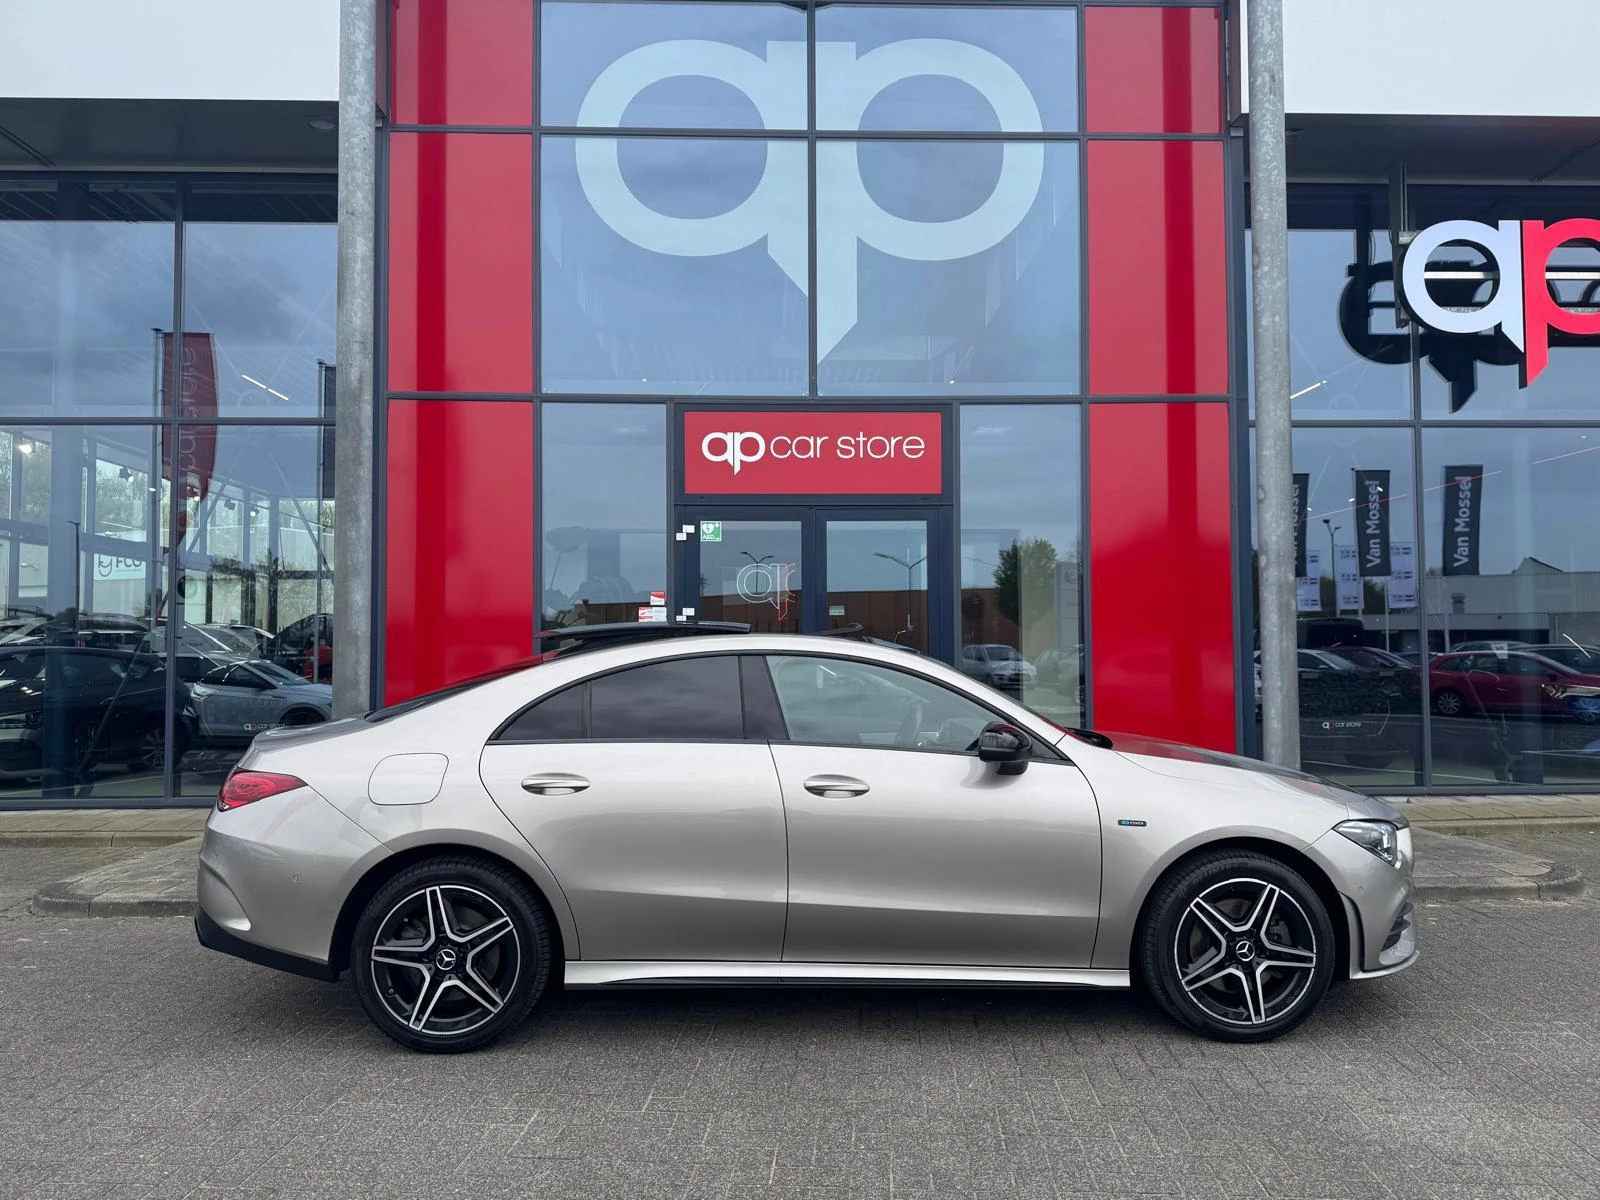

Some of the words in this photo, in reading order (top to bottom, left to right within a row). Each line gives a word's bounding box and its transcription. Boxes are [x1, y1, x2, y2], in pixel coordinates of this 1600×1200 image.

[576, 38, 1044, 364] ap
[702, 431, 766, 475] ap
[770, 436, 828, 459] car
[836, 431, 925, 459] store
[1365, 480, 1381, 535] Mossel
[1454, 476, 1472, 532] Mossel
[1365, 540, 1381, 568] Van
[1453, 537, 1471, 567] Van
